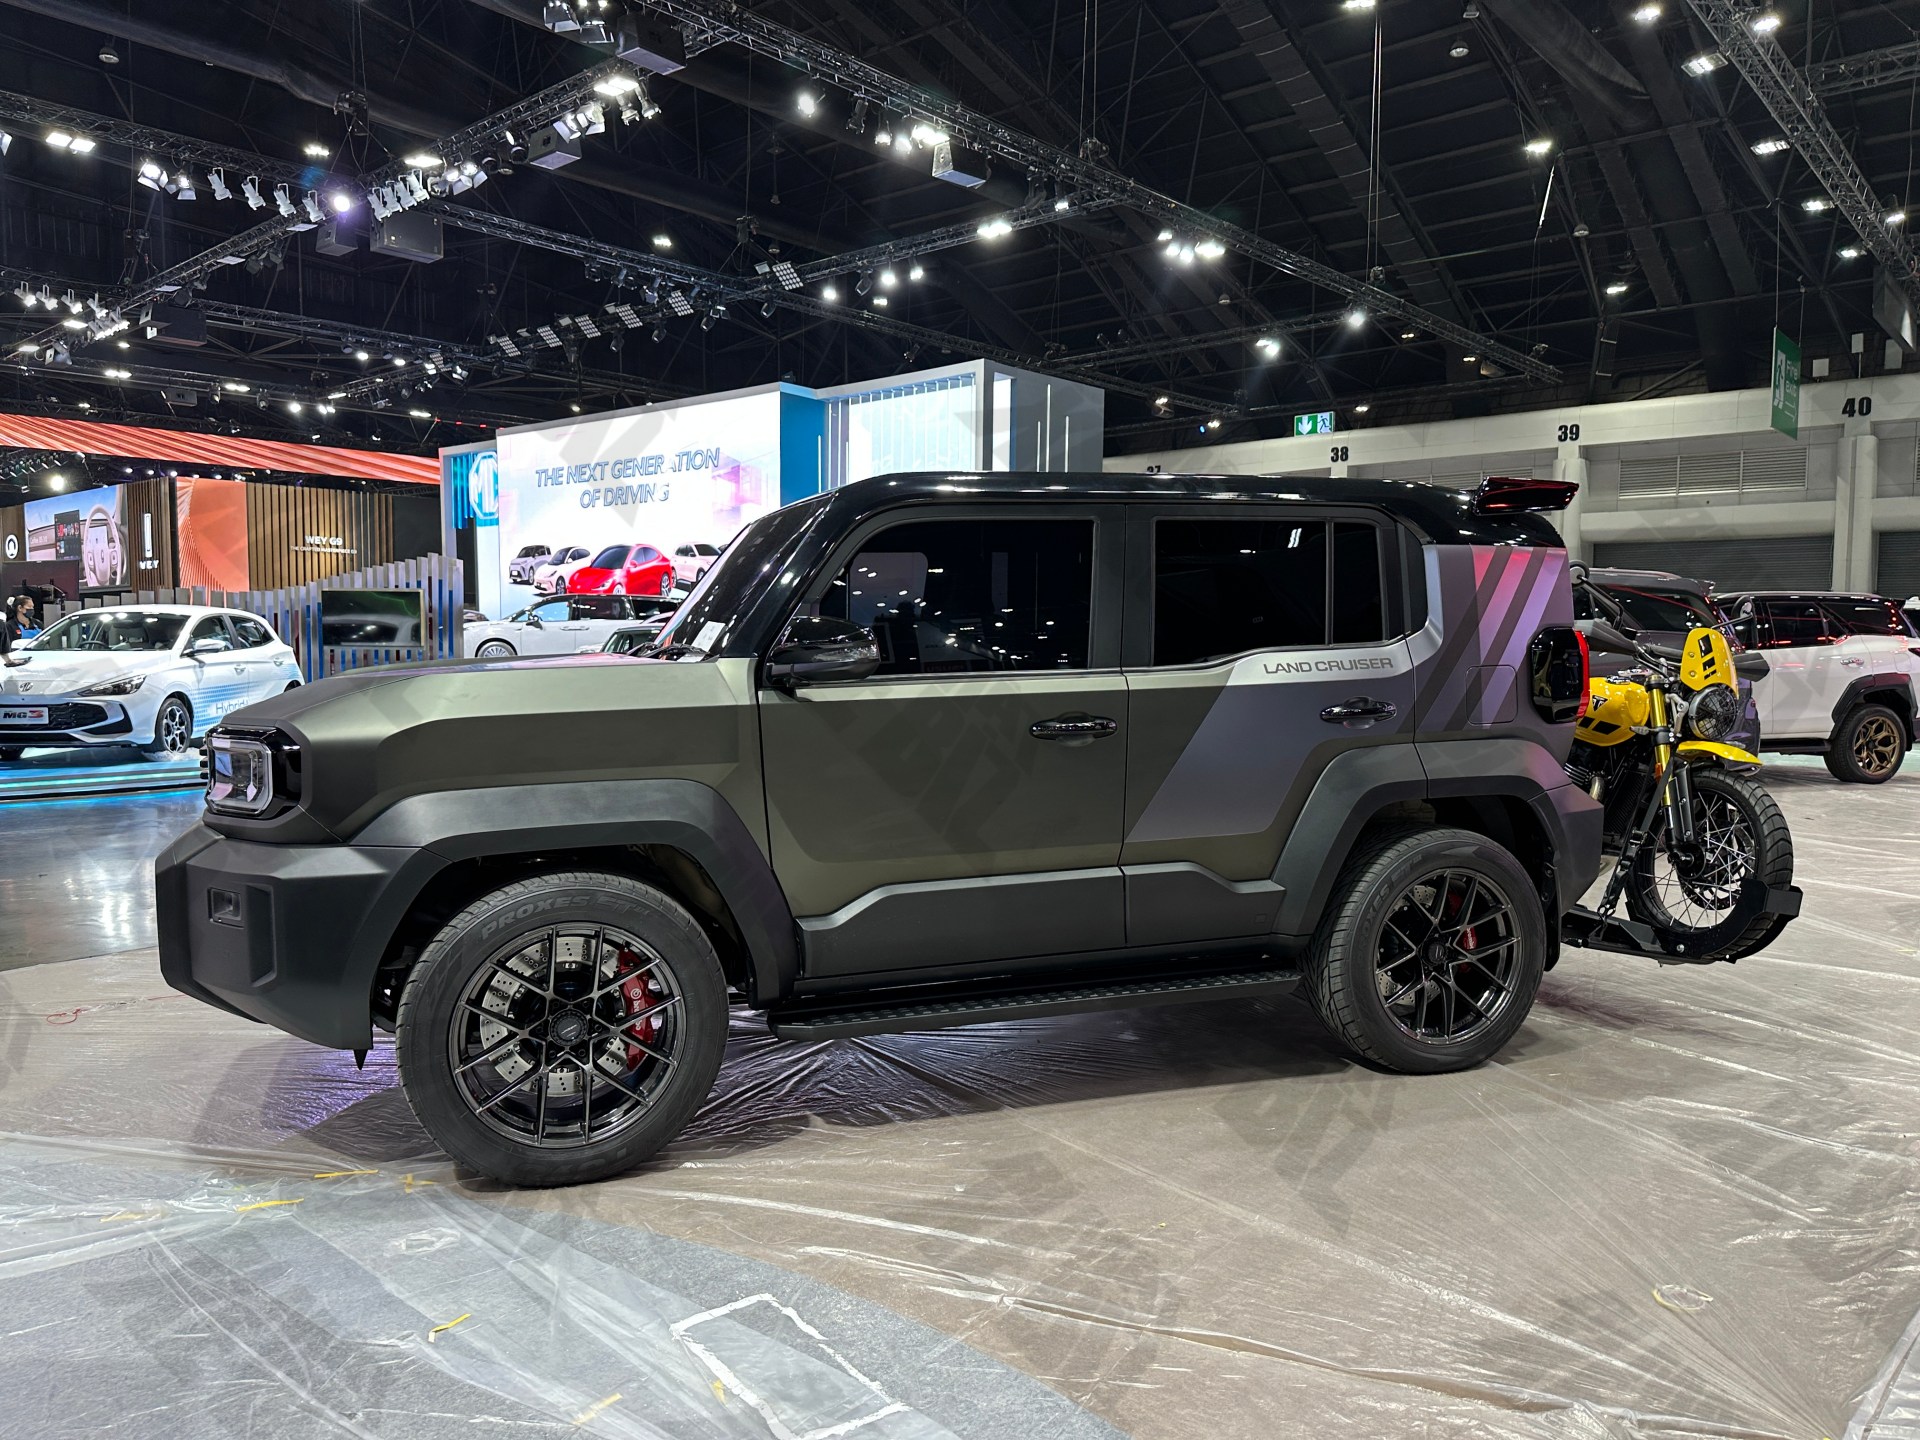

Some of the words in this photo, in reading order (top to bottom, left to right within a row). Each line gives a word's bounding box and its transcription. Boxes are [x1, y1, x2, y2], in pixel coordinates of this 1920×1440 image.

[1842, 397, 1872, 418] 40
[1558, 424, 1580, 442] 39
[1331, 447, 1349, 463] 38
[535, 466, 564, 487] THE
[566, 461, 609, 484] NEXT
[579, 489, 601, 508] OF
[305, 536, 326, 544] WEY
[139, 560, 159, 570] WEY
[1263, 661, 1313, 674] LAND
[1315, 657, 1394, 672] CRUISER
[481, 895, 591, 940] PROXES
